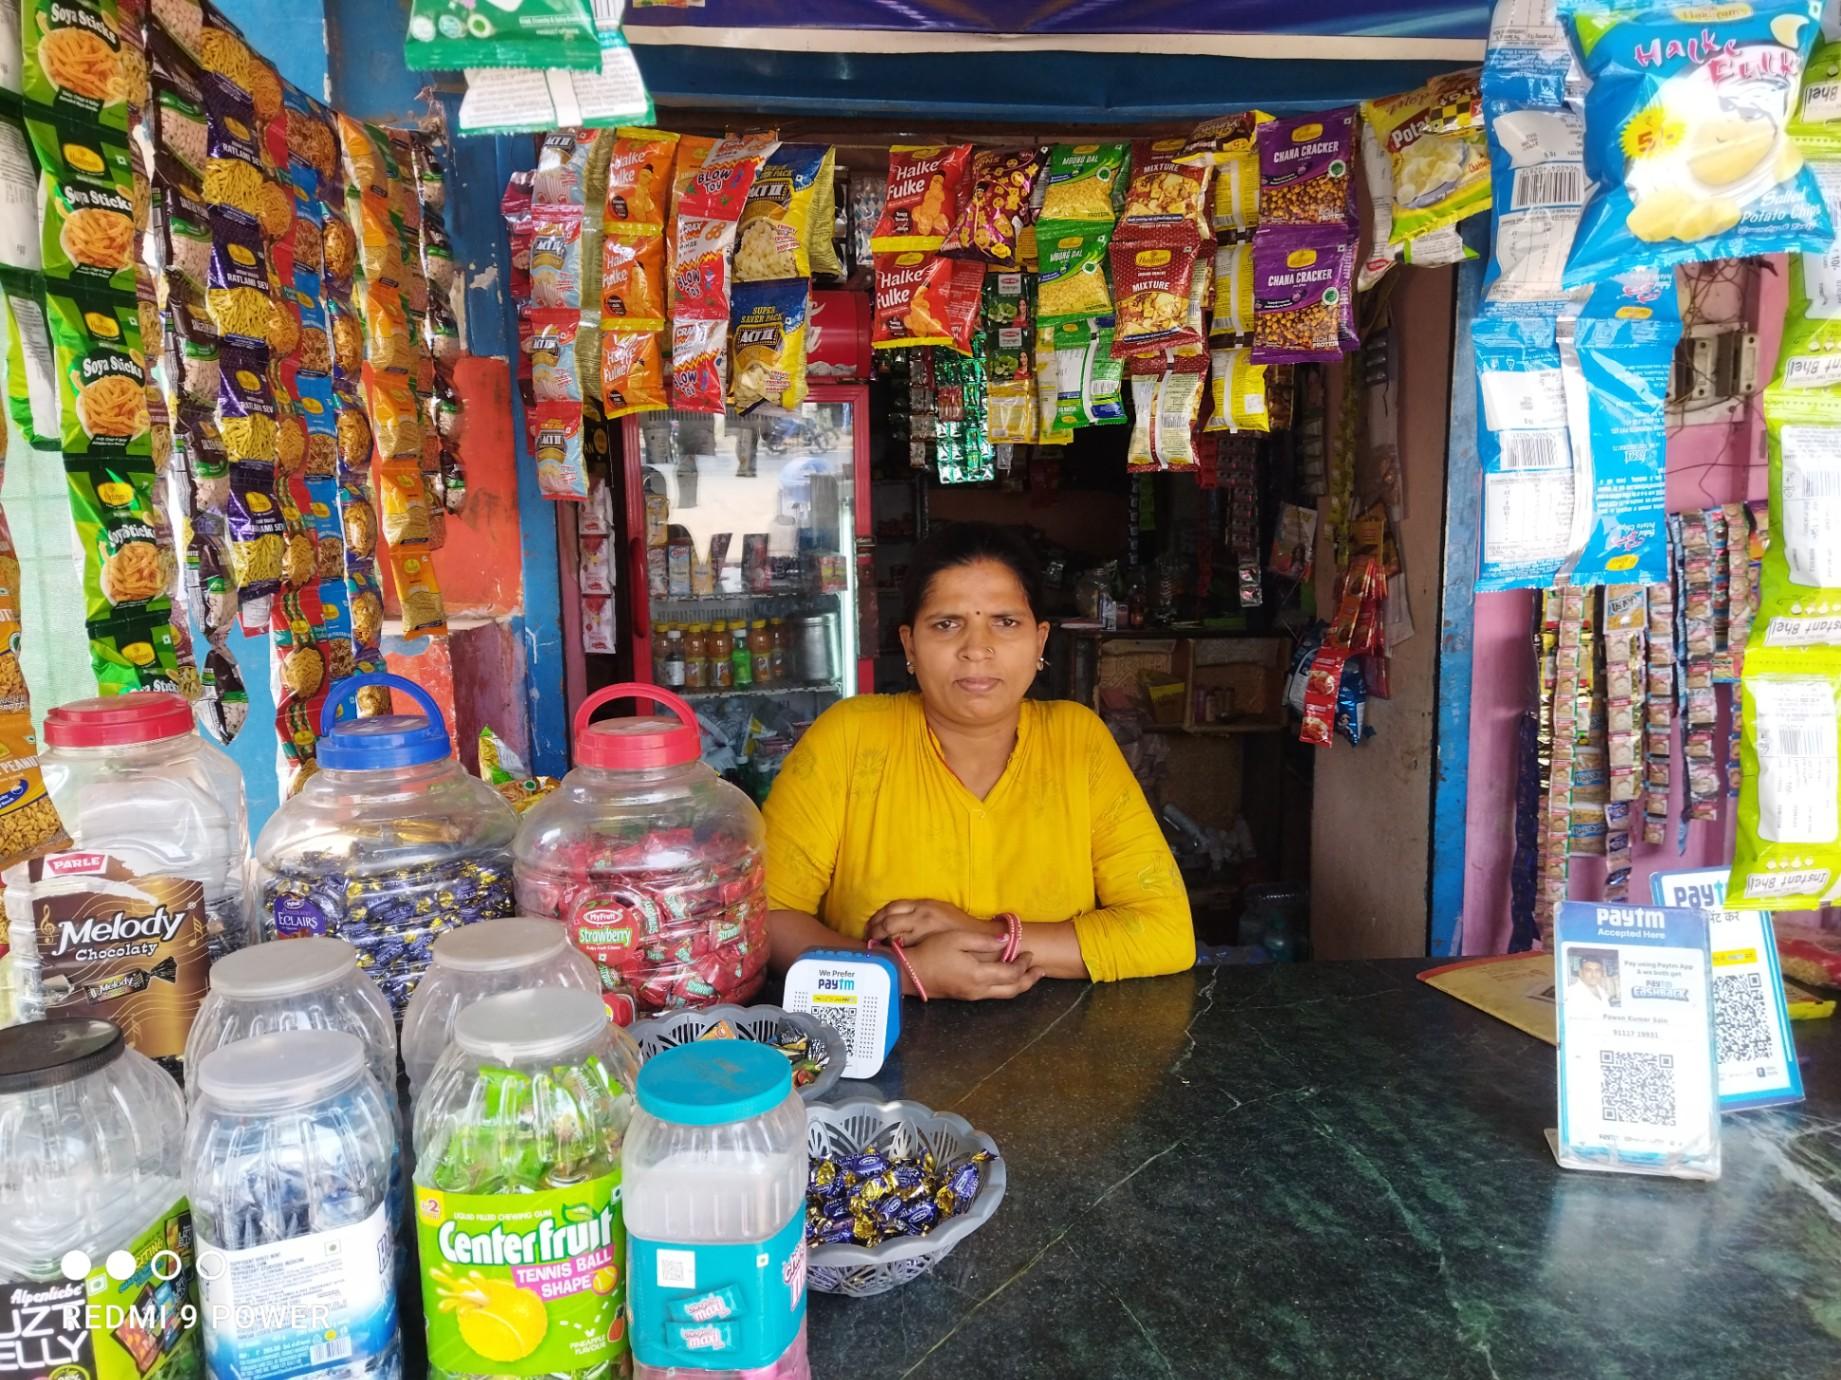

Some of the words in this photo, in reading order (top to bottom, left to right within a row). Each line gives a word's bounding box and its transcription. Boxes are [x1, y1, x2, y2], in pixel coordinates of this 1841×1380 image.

[51, 3, 77, 25] Soya
[78, 10, 117, 44] Sticks
[1634, 28, 1742, 67] Halke
[1274, 149, 1300, 164] CHANA
[1301, 140, 1340, 157] CRACKER
[697, 169, 733, 184] BLOW
[896, 160, 940, 182] Halke
[1143, 163, 1180, 174] MIXTURE
[704, 180, 723, 193] TOY
[887, 178, 926, 200] Fulke
[1740, 208, 1787, 225] Potato
[881, 269, 924, 289] Halke
[1132, 280, 1170, 292] MIXTURE
[1268, 273, 1295, 287] CHANA
[1295, 268, 1333, 283] CRACKER
[877, 288, 911, 309] Fulke
[83, 357, 109, 378] Soya
[110, 355, 142, 379] Sticks
[53, 856, 101, 870] PARLE
[278, 911, 318, 929] ECLAIRS
[51, 906, 186, 956] Melody
[579, 927, 632, 947] Strawberry
[1597, 928, 1642, 939] Accepted
[1643, 930, 1666, 940] Here
[75, 943, 158, 961] Chocolaty
[819, 969, 831, 977] We
[832, 970, 855, 978] Prefer
[1624, 960, 1636, 968] Pay
[533, 1208, 553, 1219] GUM
[517, 1262, 573, 1284] TENNIS
[576, 1251, 613, 1273] BALL
[10, 1284, 84, 1307] Alpenliebe
[540, 1277, 592, 1298] SHAPE
